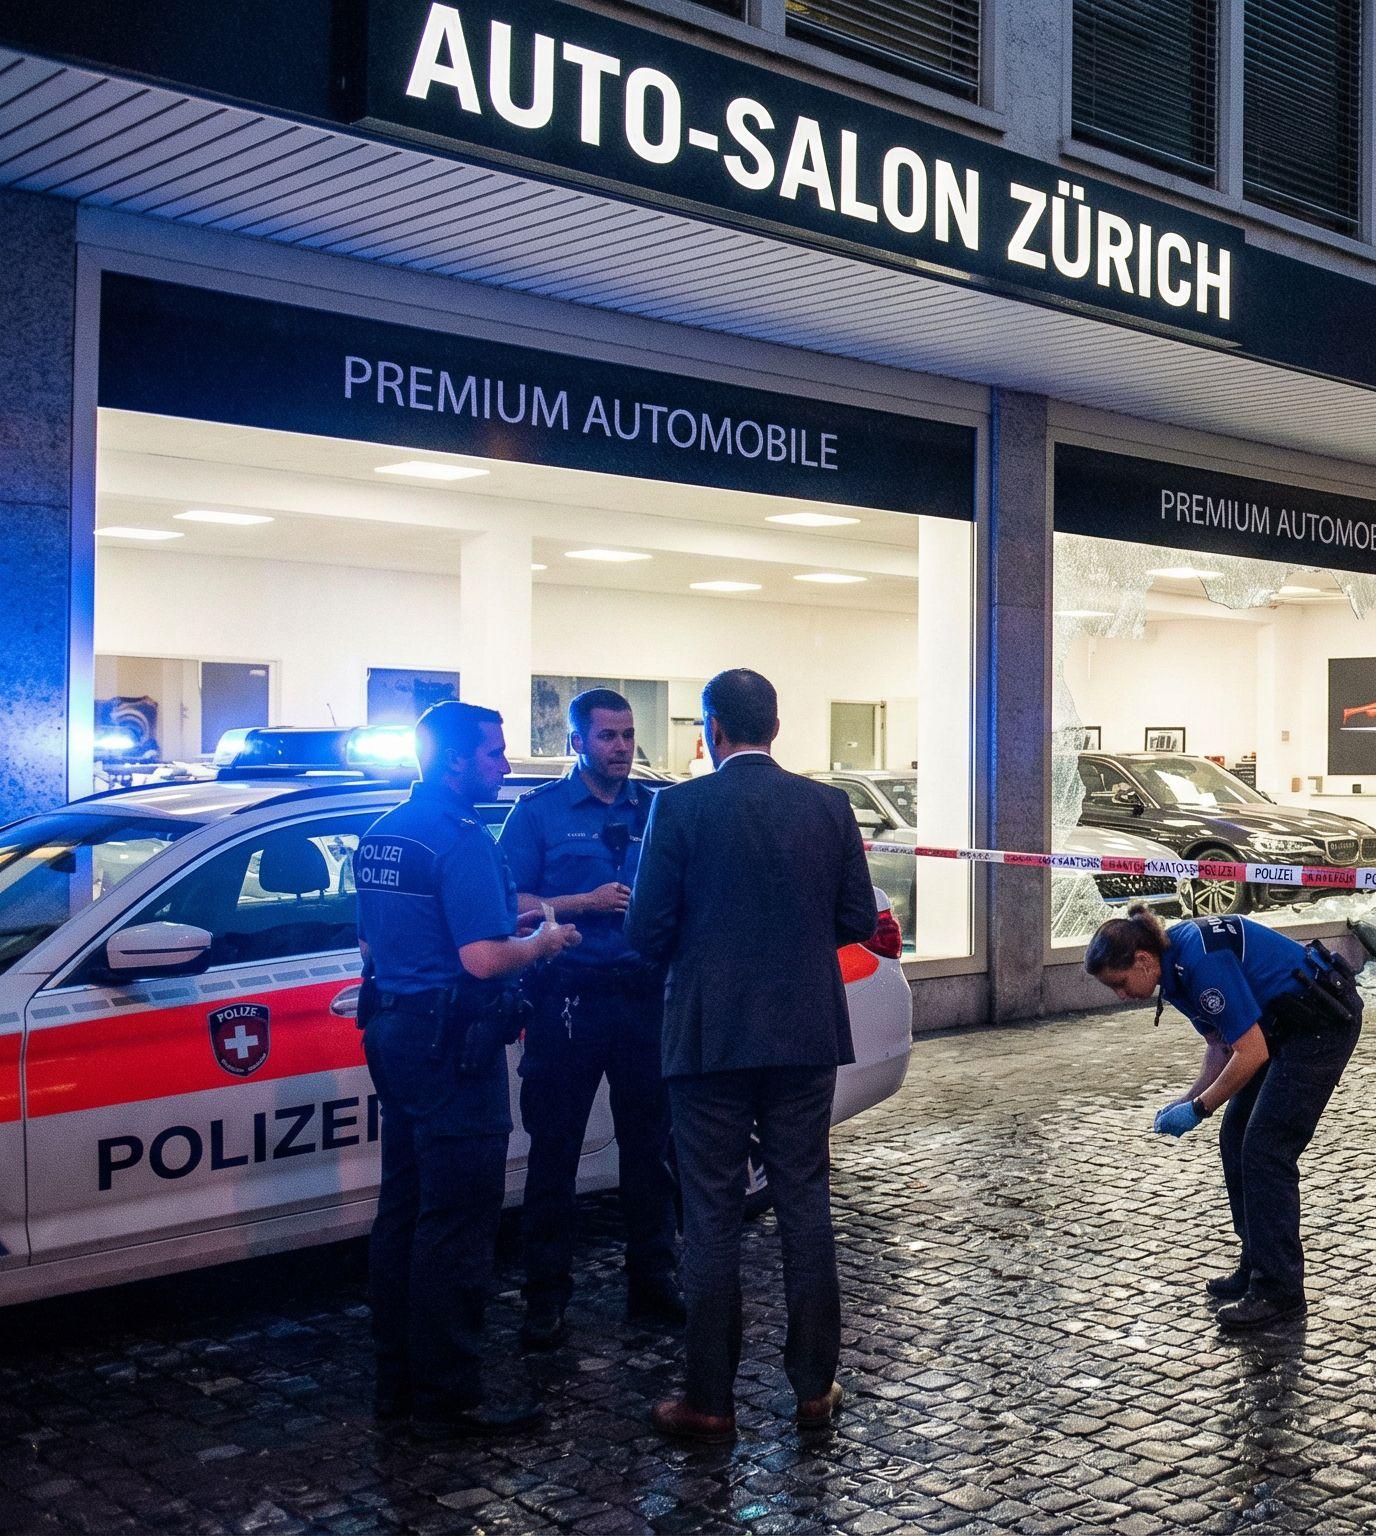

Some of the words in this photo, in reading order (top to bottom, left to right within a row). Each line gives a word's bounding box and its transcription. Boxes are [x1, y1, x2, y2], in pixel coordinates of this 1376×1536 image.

[405, 2, 980, 251] AUTO-SALON
[1007, 180, 1232, 321] ZÜRICH
[344, 355, 569, 431] PREMIUM
[583, 394, 839, 471] AUTOMOBILE
[1161, 489, 1270, 535] PREMIUM
[1255, 866, 1293, 881] POLIZEI
[98, 1094, 379, 1192] POLIZEI
